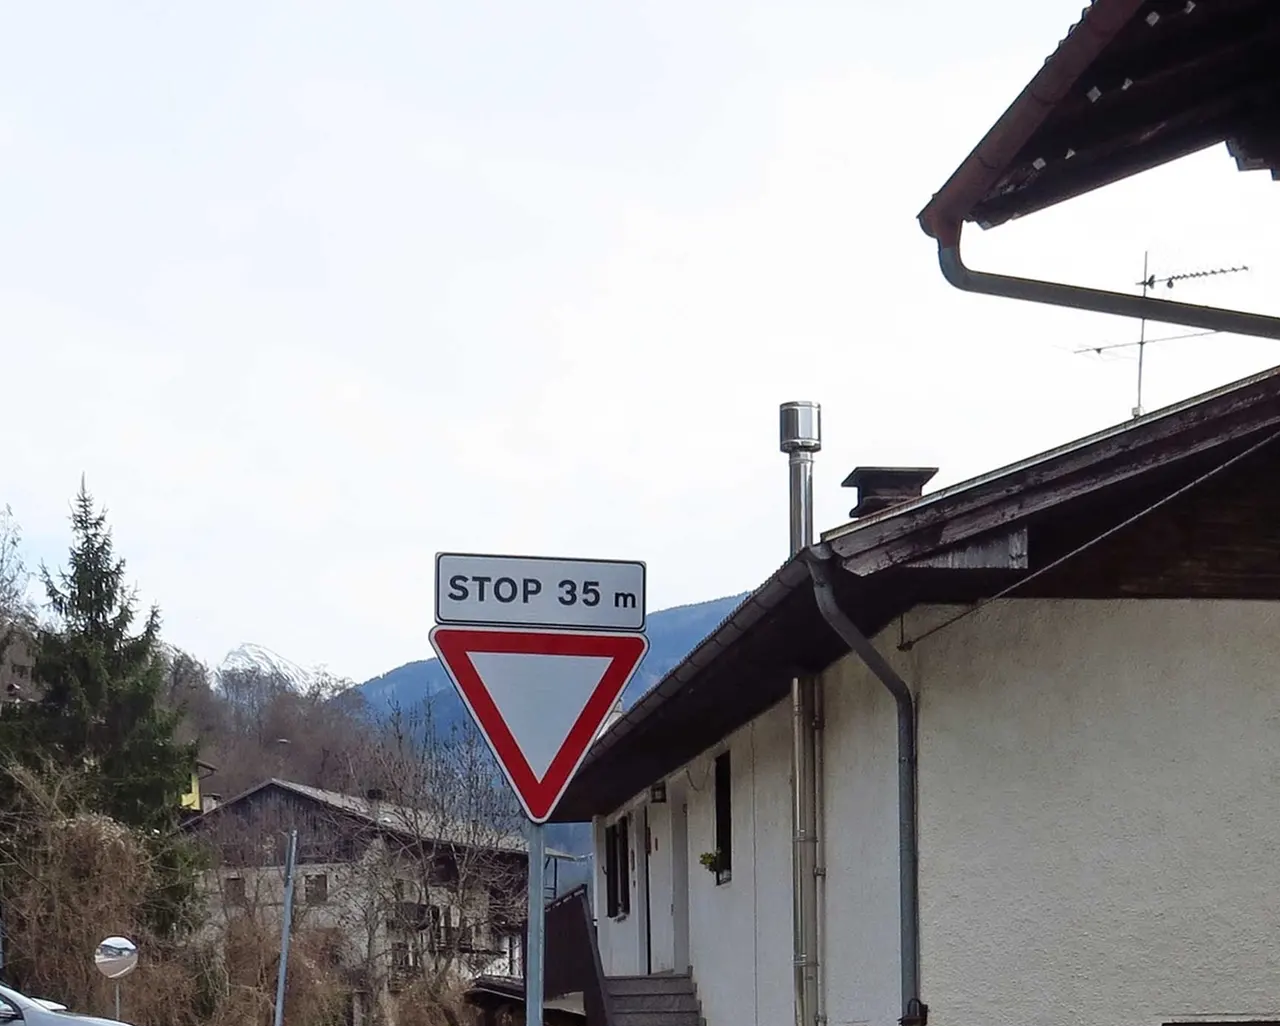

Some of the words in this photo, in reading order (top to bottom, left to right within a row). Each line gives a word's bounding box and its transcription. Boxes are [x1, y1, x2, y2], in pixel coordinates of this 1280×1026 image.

[447, 574, 543, 604] STOP
[557, 579, 601, 607] 35
[613, 590, 637, 609] m
